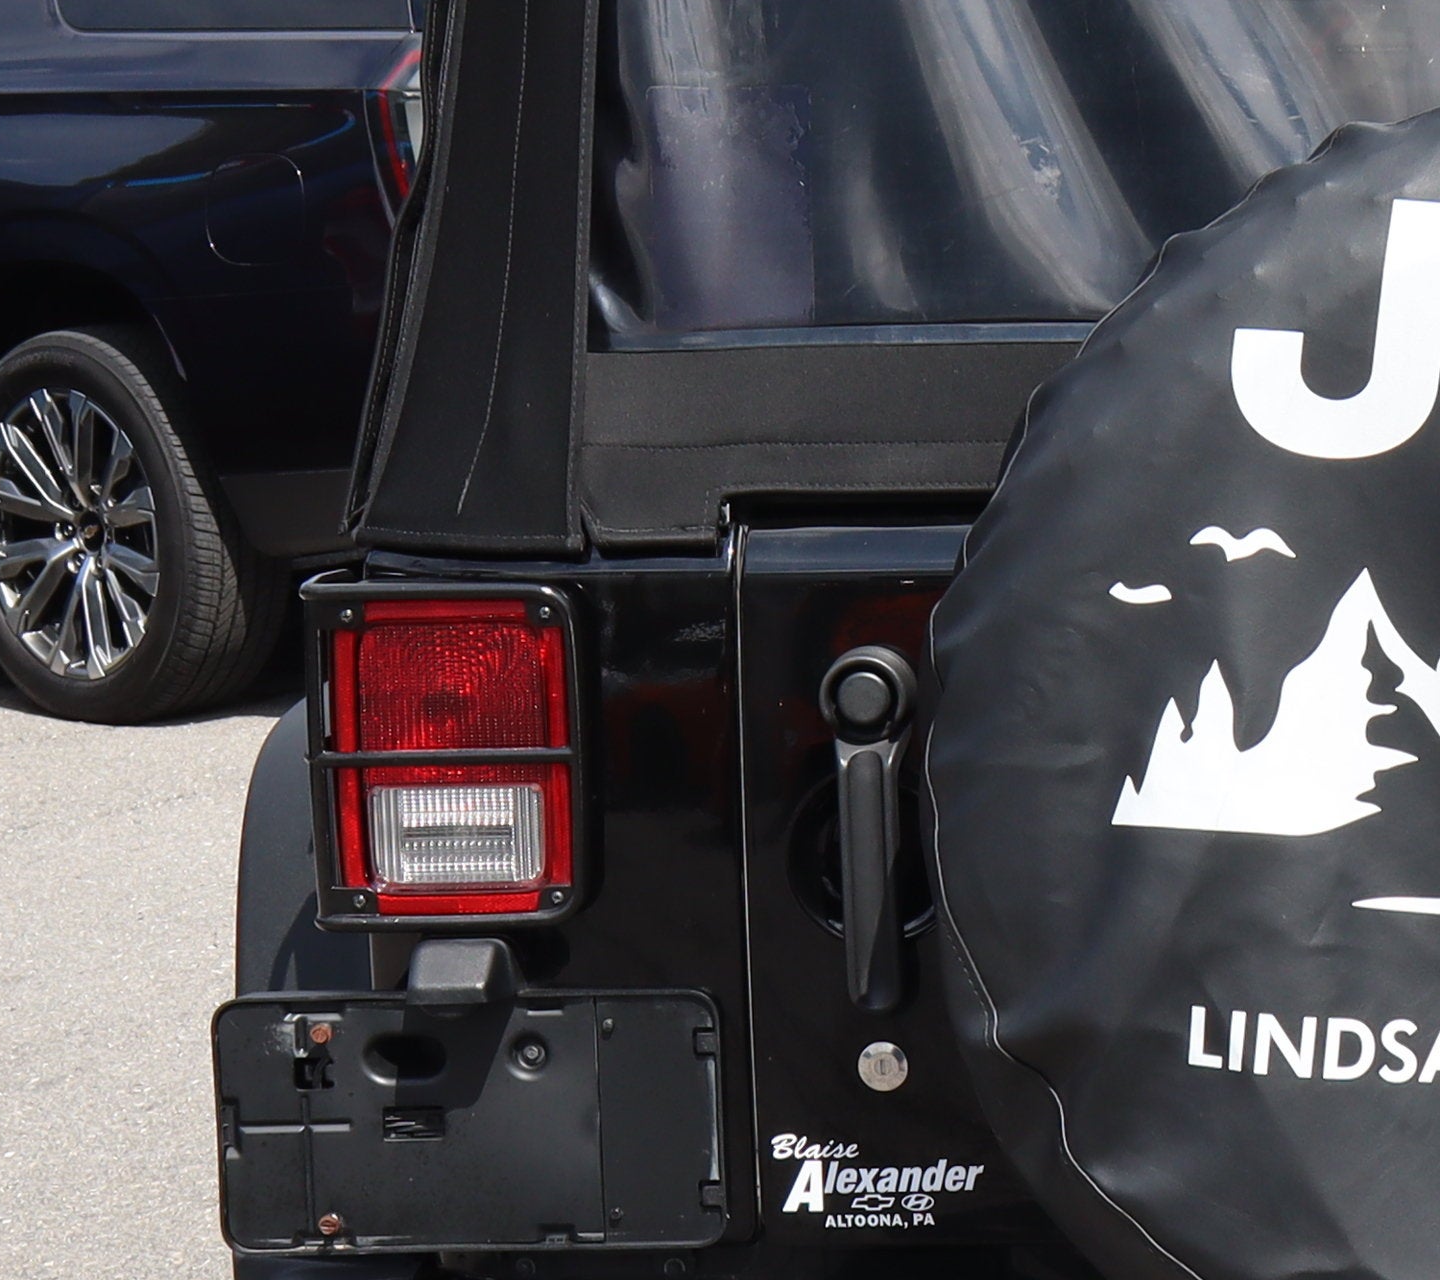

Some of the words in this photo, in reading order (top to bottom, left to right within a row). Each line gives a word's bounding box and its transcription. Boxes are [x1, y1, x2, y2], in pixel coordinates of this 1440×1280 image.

[770, 1133, 860, 1160] Blaise
[782, 1158, 985, 1213] Alexander
[825, 1213, 908, 1229] ALTOONA,
[913, 1212, 935, 1226] PA
